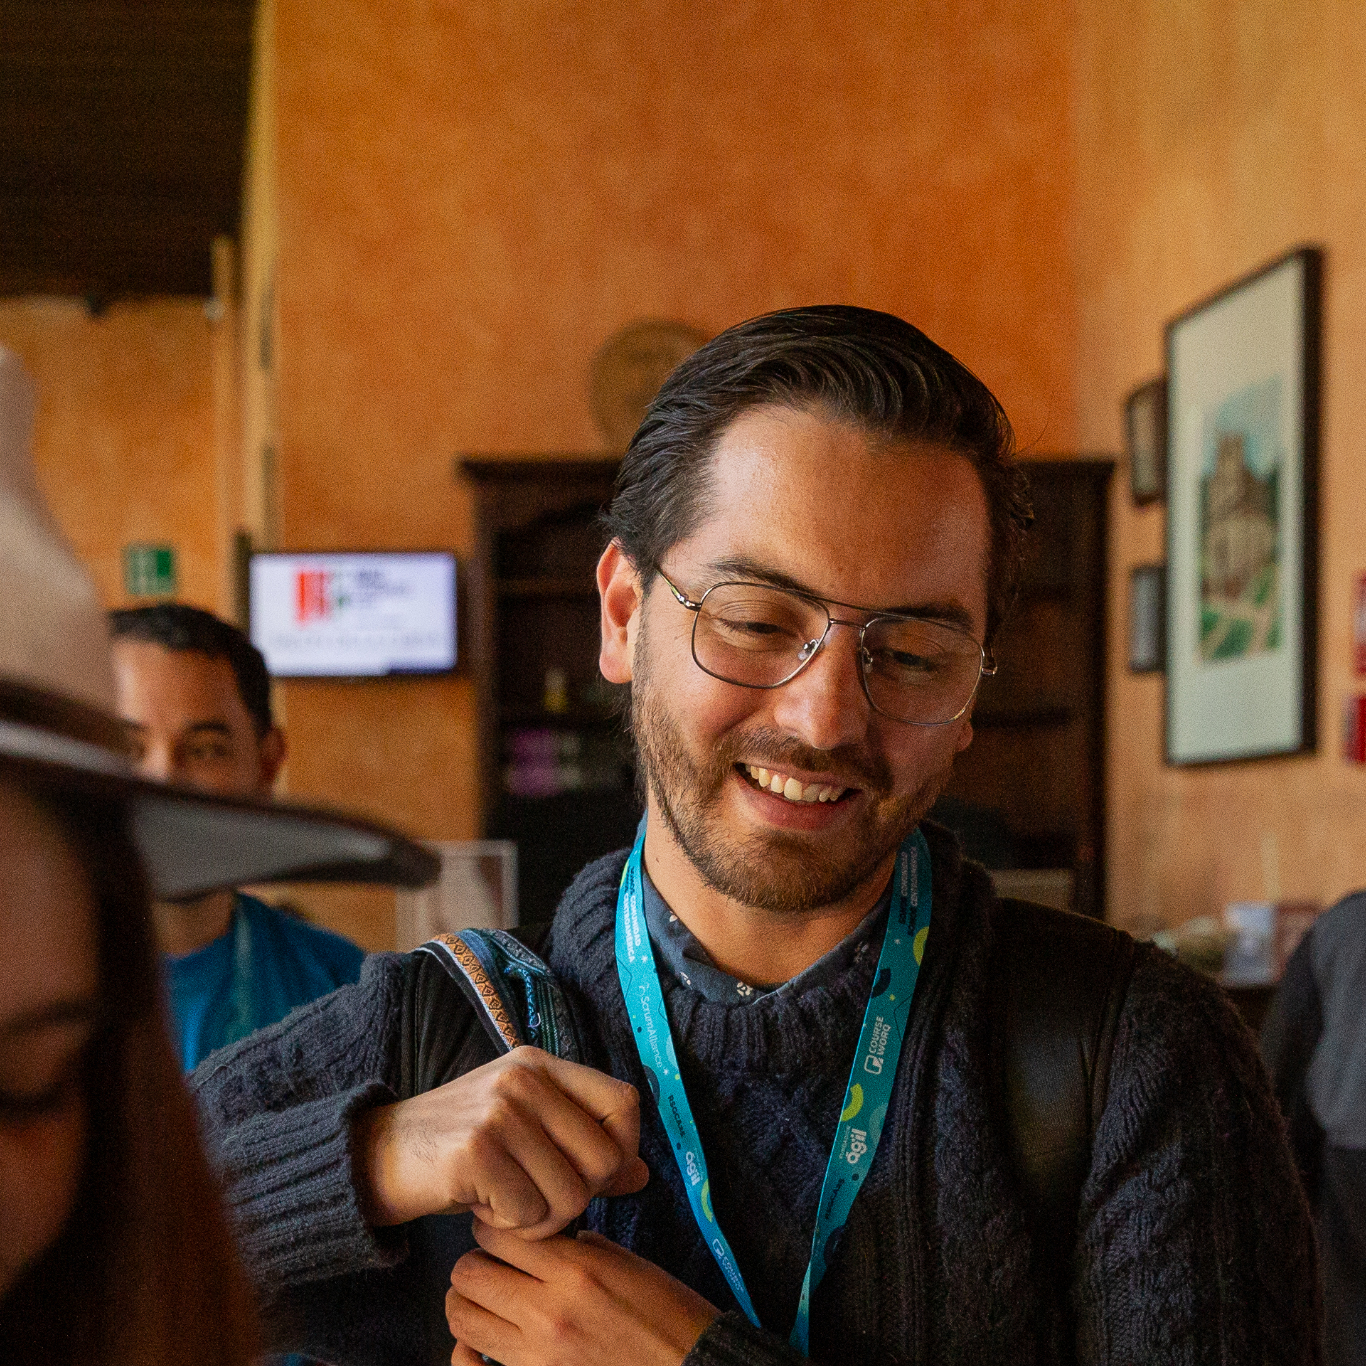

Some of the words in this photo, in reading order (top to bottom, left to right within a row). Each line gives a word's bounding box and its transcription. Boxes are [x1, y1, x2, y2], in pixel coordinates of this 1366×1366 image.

[630, 895, 641, 947] COMUNIDAD
[869, 1016, 884, 1054] COURSE
[876, 1023, 891, 1056] WORQ
